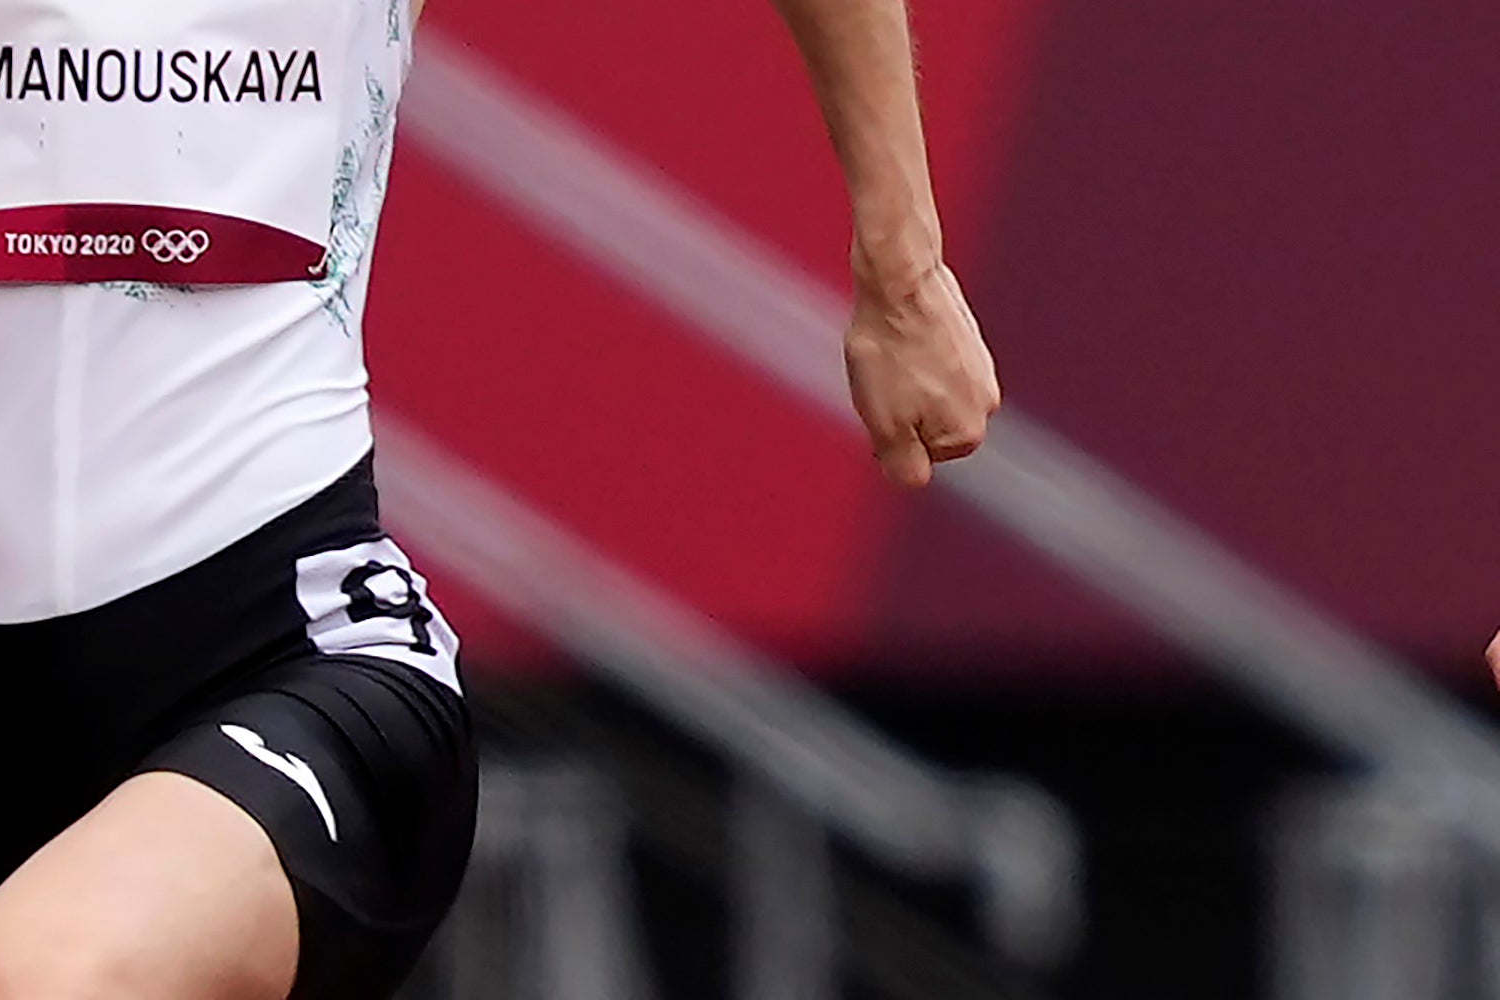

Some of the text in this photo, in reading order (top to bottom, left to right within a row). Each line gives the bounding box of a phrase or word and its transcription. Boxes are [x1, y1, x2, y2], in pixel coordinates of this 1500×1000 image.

[4, 232, 135, 256] TOKYO 2020
[341, 559, 437, 657] 9
